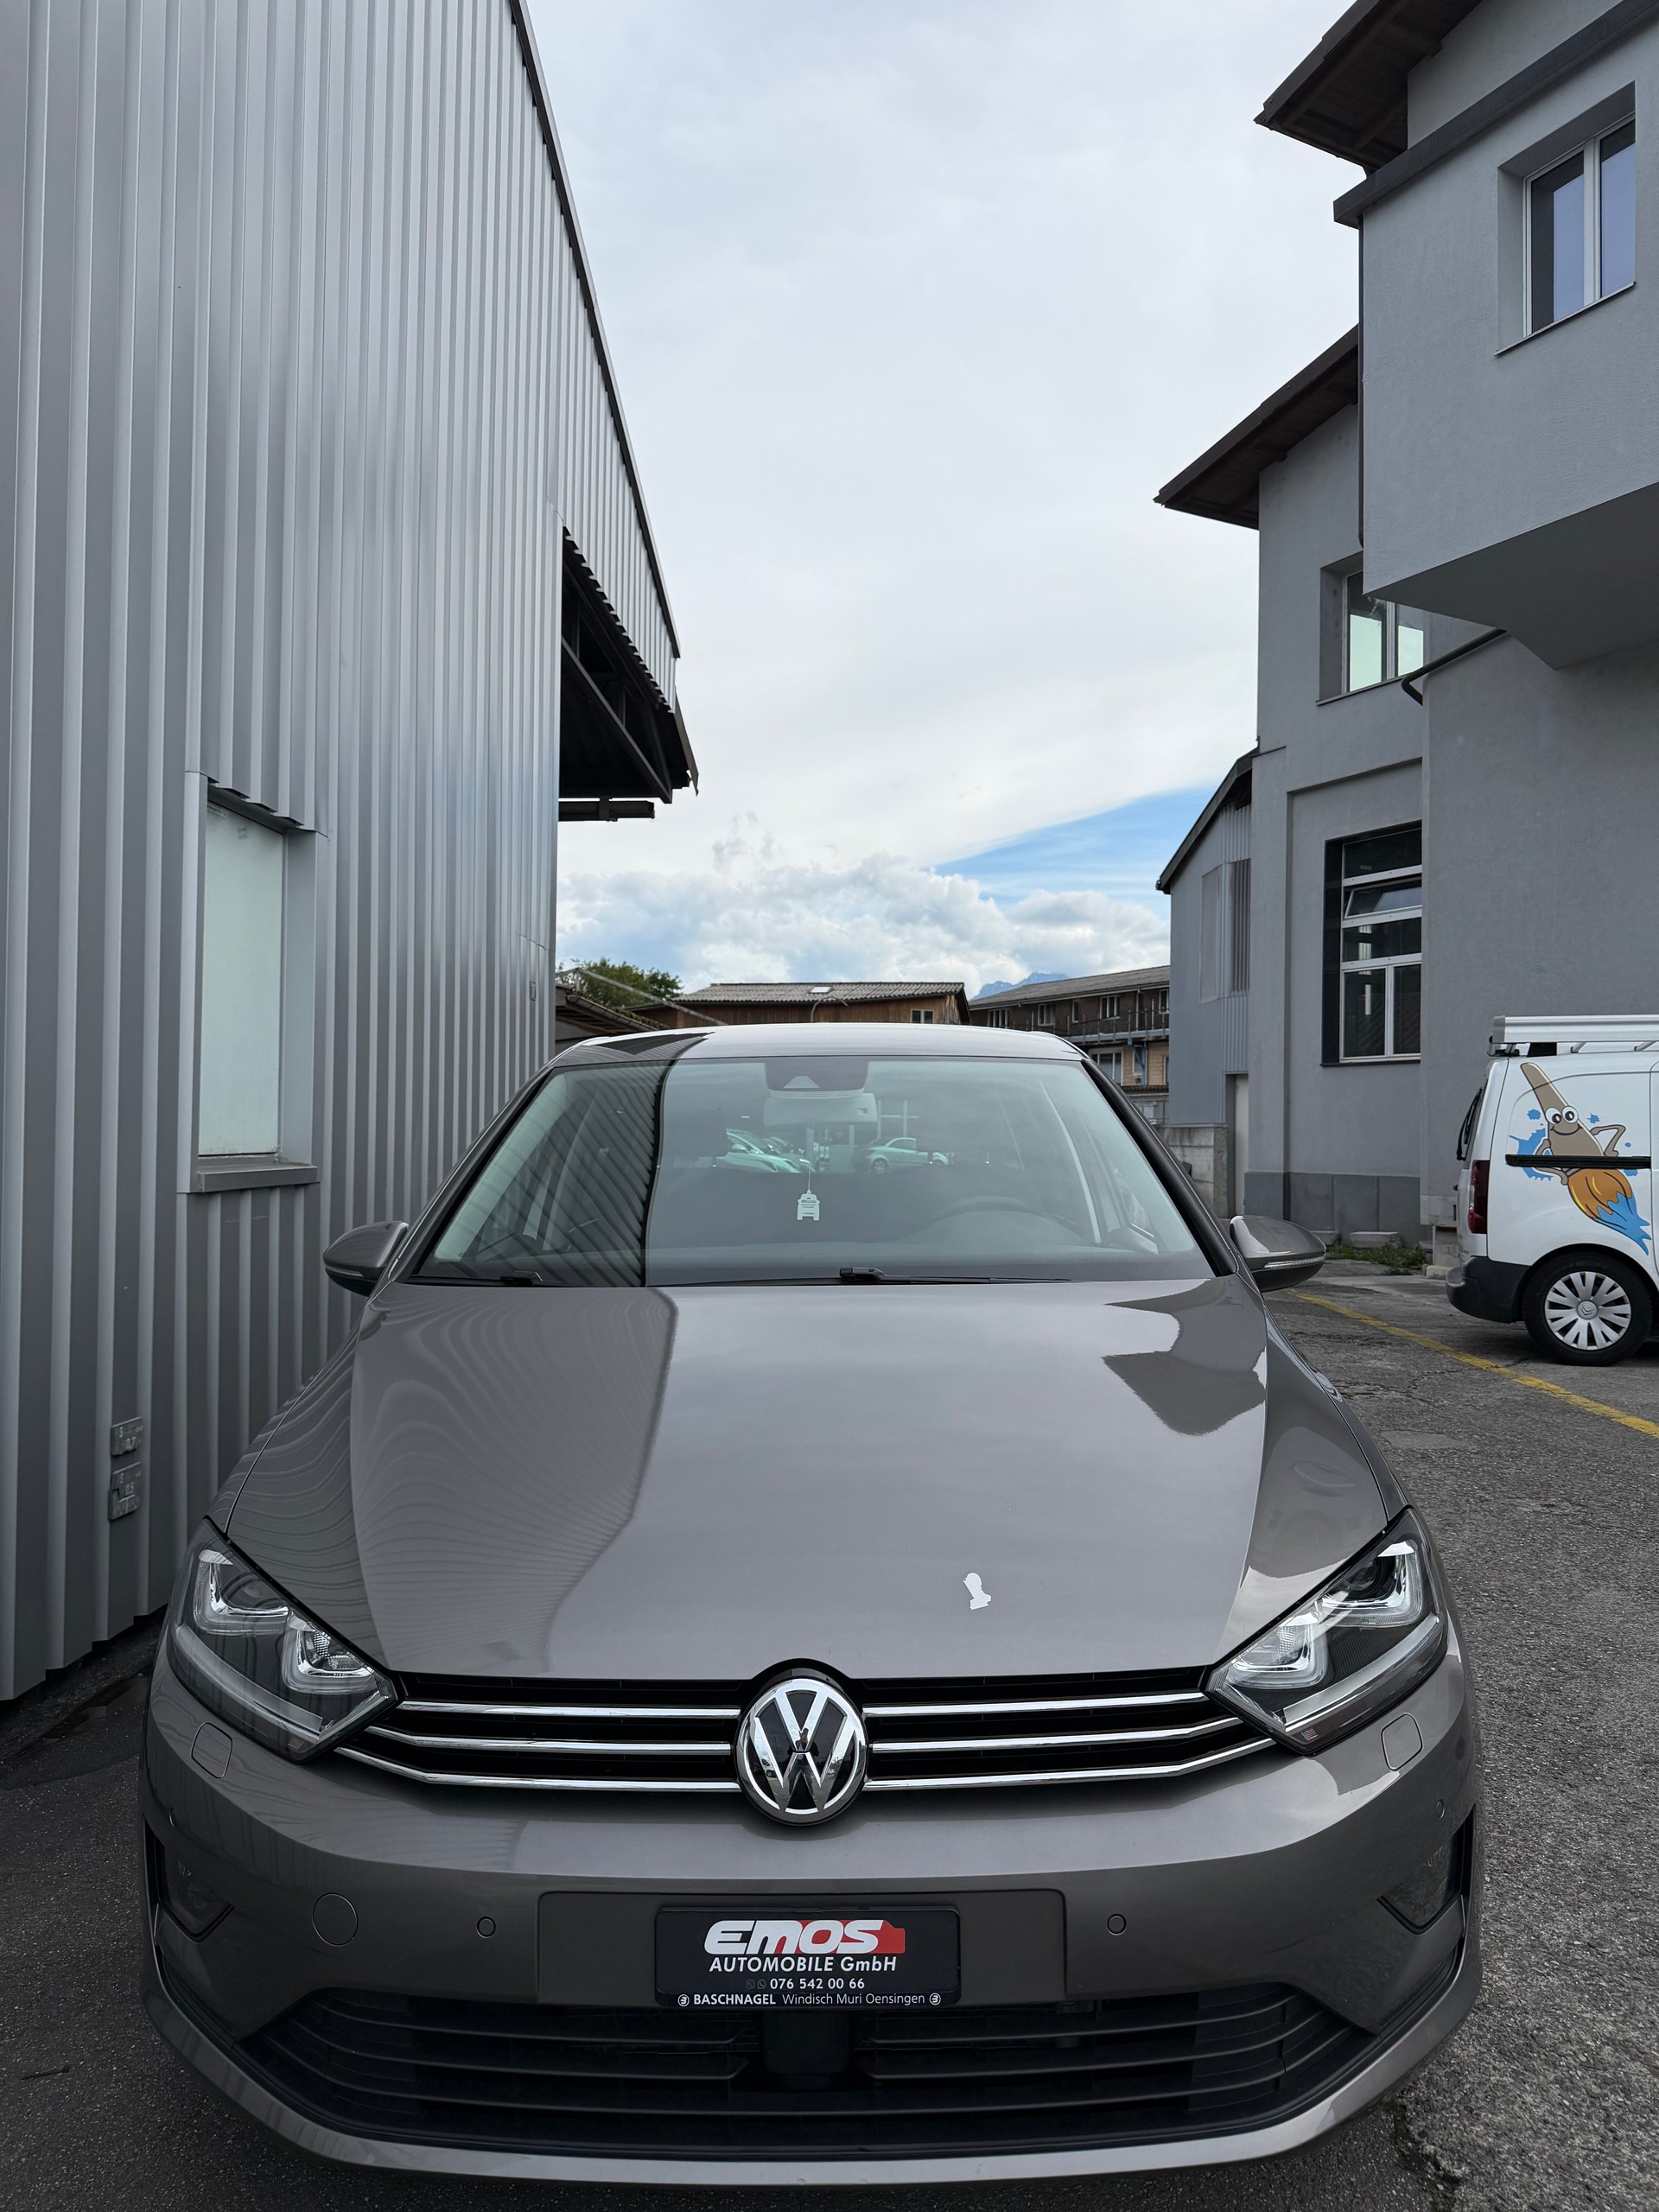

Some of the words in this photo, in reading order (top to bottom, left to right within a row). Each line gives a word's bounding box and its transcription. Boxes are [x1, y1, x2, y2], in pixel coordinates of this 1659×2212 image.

[709, 1956, 835, 1973] AUTOMOBILE
[840, 1955, 897, 1972] GmbH
[770, 1978, 794, 1990] 076
[799, 1978, 823, 1990] 542
[827, 1978, 844, 1990] 00
[849, 1978, 865, 1989] 66
[693, 1993, 777, 2005] BASCHNAGEL
[782, 1993, 833, 2005] Windisch
[836, 1993, 862, 2005] Muri
[865, 1993, 925, 2006] Oensingen
